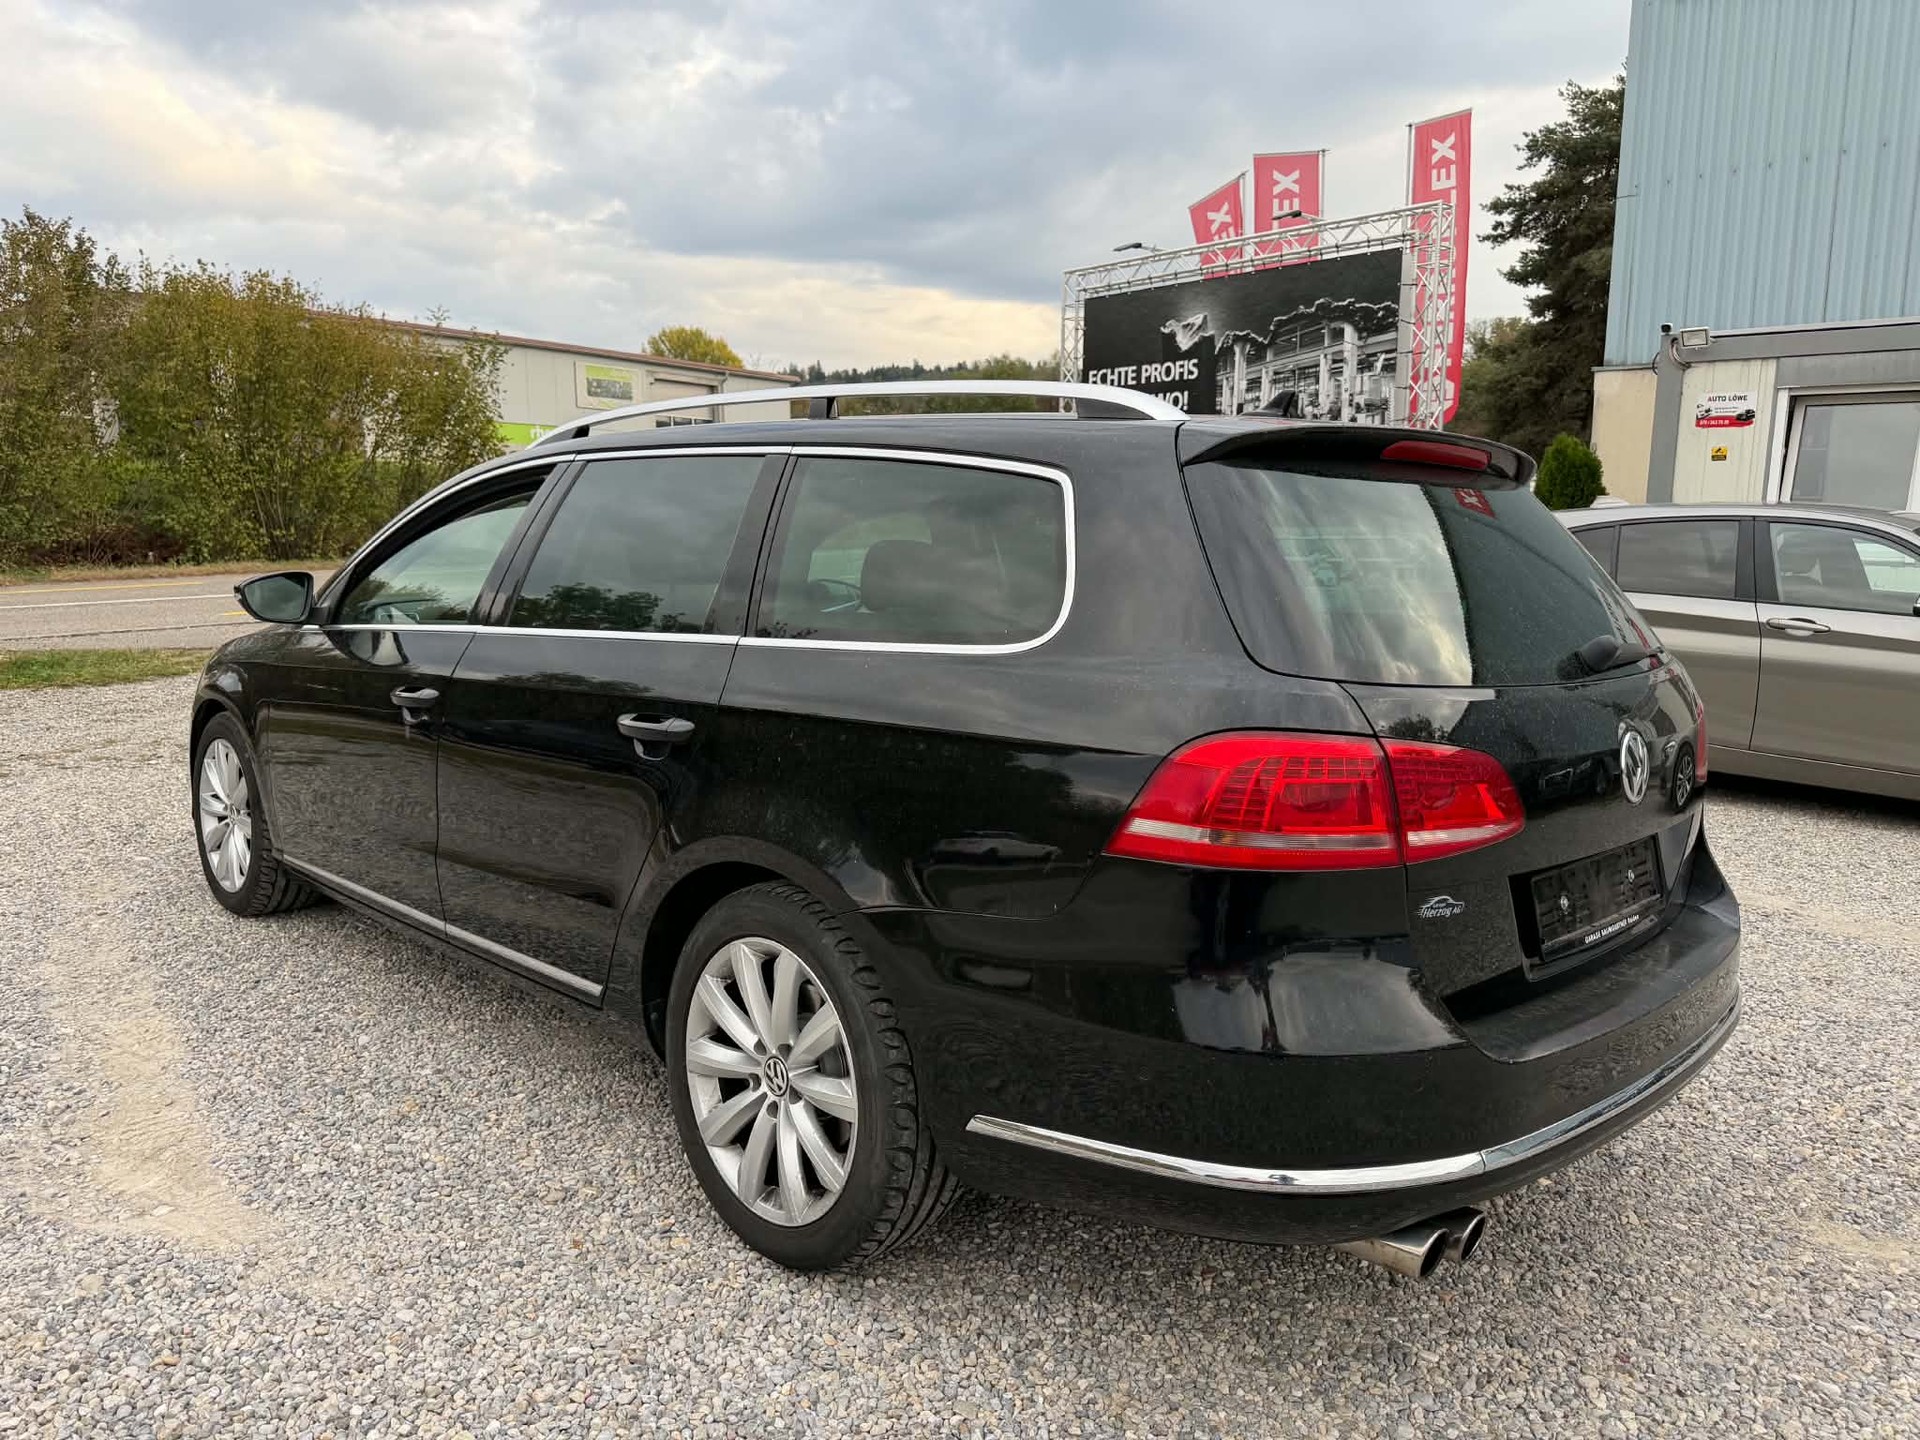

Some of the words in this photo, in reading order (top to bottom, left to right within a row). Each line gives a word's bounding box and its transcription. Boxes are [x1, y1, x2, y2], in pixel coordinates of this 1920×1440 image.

[1088, 365, 1137, 386] ECHTE
[1141, 359, 1199, 384] PROFIS
[1422, 907, 1452, 918] Herzog
